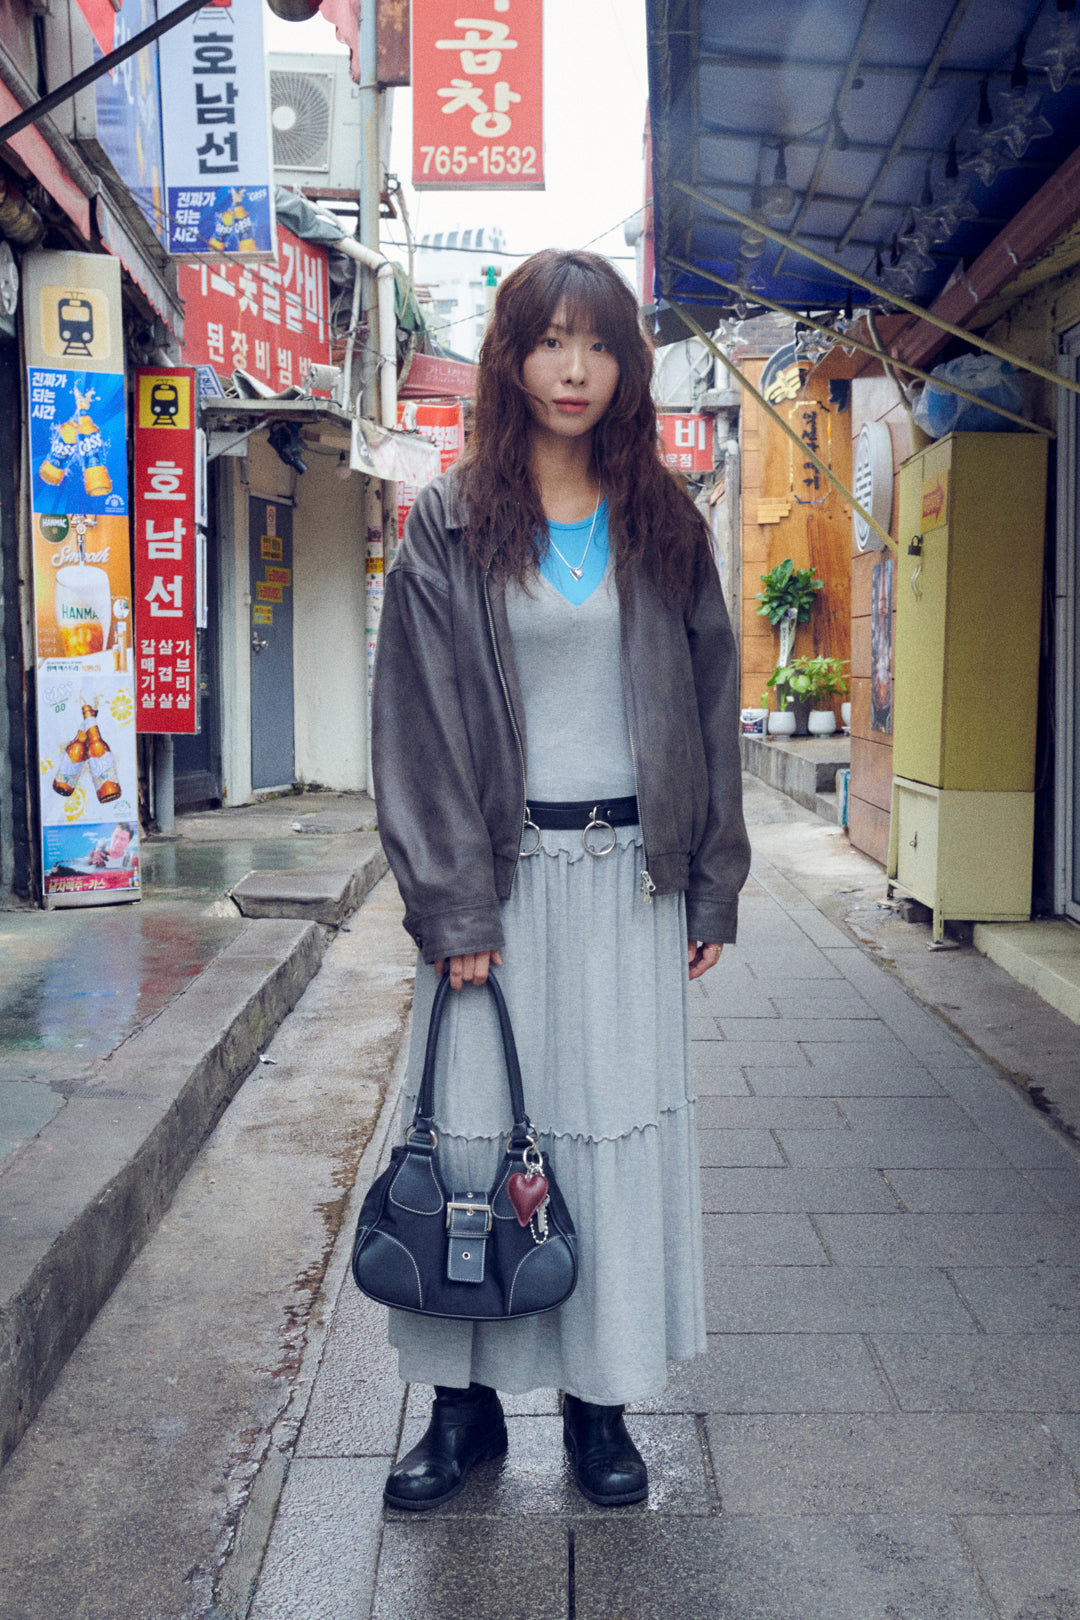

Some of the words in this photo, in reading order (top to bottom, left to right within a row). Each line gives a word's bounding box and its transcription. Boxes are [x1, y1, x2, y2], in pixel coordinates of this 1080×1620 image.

[435, 0, 521, 138] 곱창
[192, 32, 240, 175] 호남선
[420, 146, 536, 174] 765-1532
[177, 191, 216, 208] 진짜가
[175, 209, 200, 225] 되는
[172, 226, 199, 242] 시간
[187, 242, 325, 344] 숯불갈비
[32, 372, 67, 388] 진짜가
[32, 388, 56, 403] 되는
[32, 404, 56, 420] 시간
[656, 420, 706, 450] 비
[658, 453, 692, 468] 문점
[144, 460, 187, 618] 호남선
[141, 639, 156, 709] 갈매기살
[158, 639, 173, 709] 삼겹살
[175, 639, 191, 709] 가브리살
